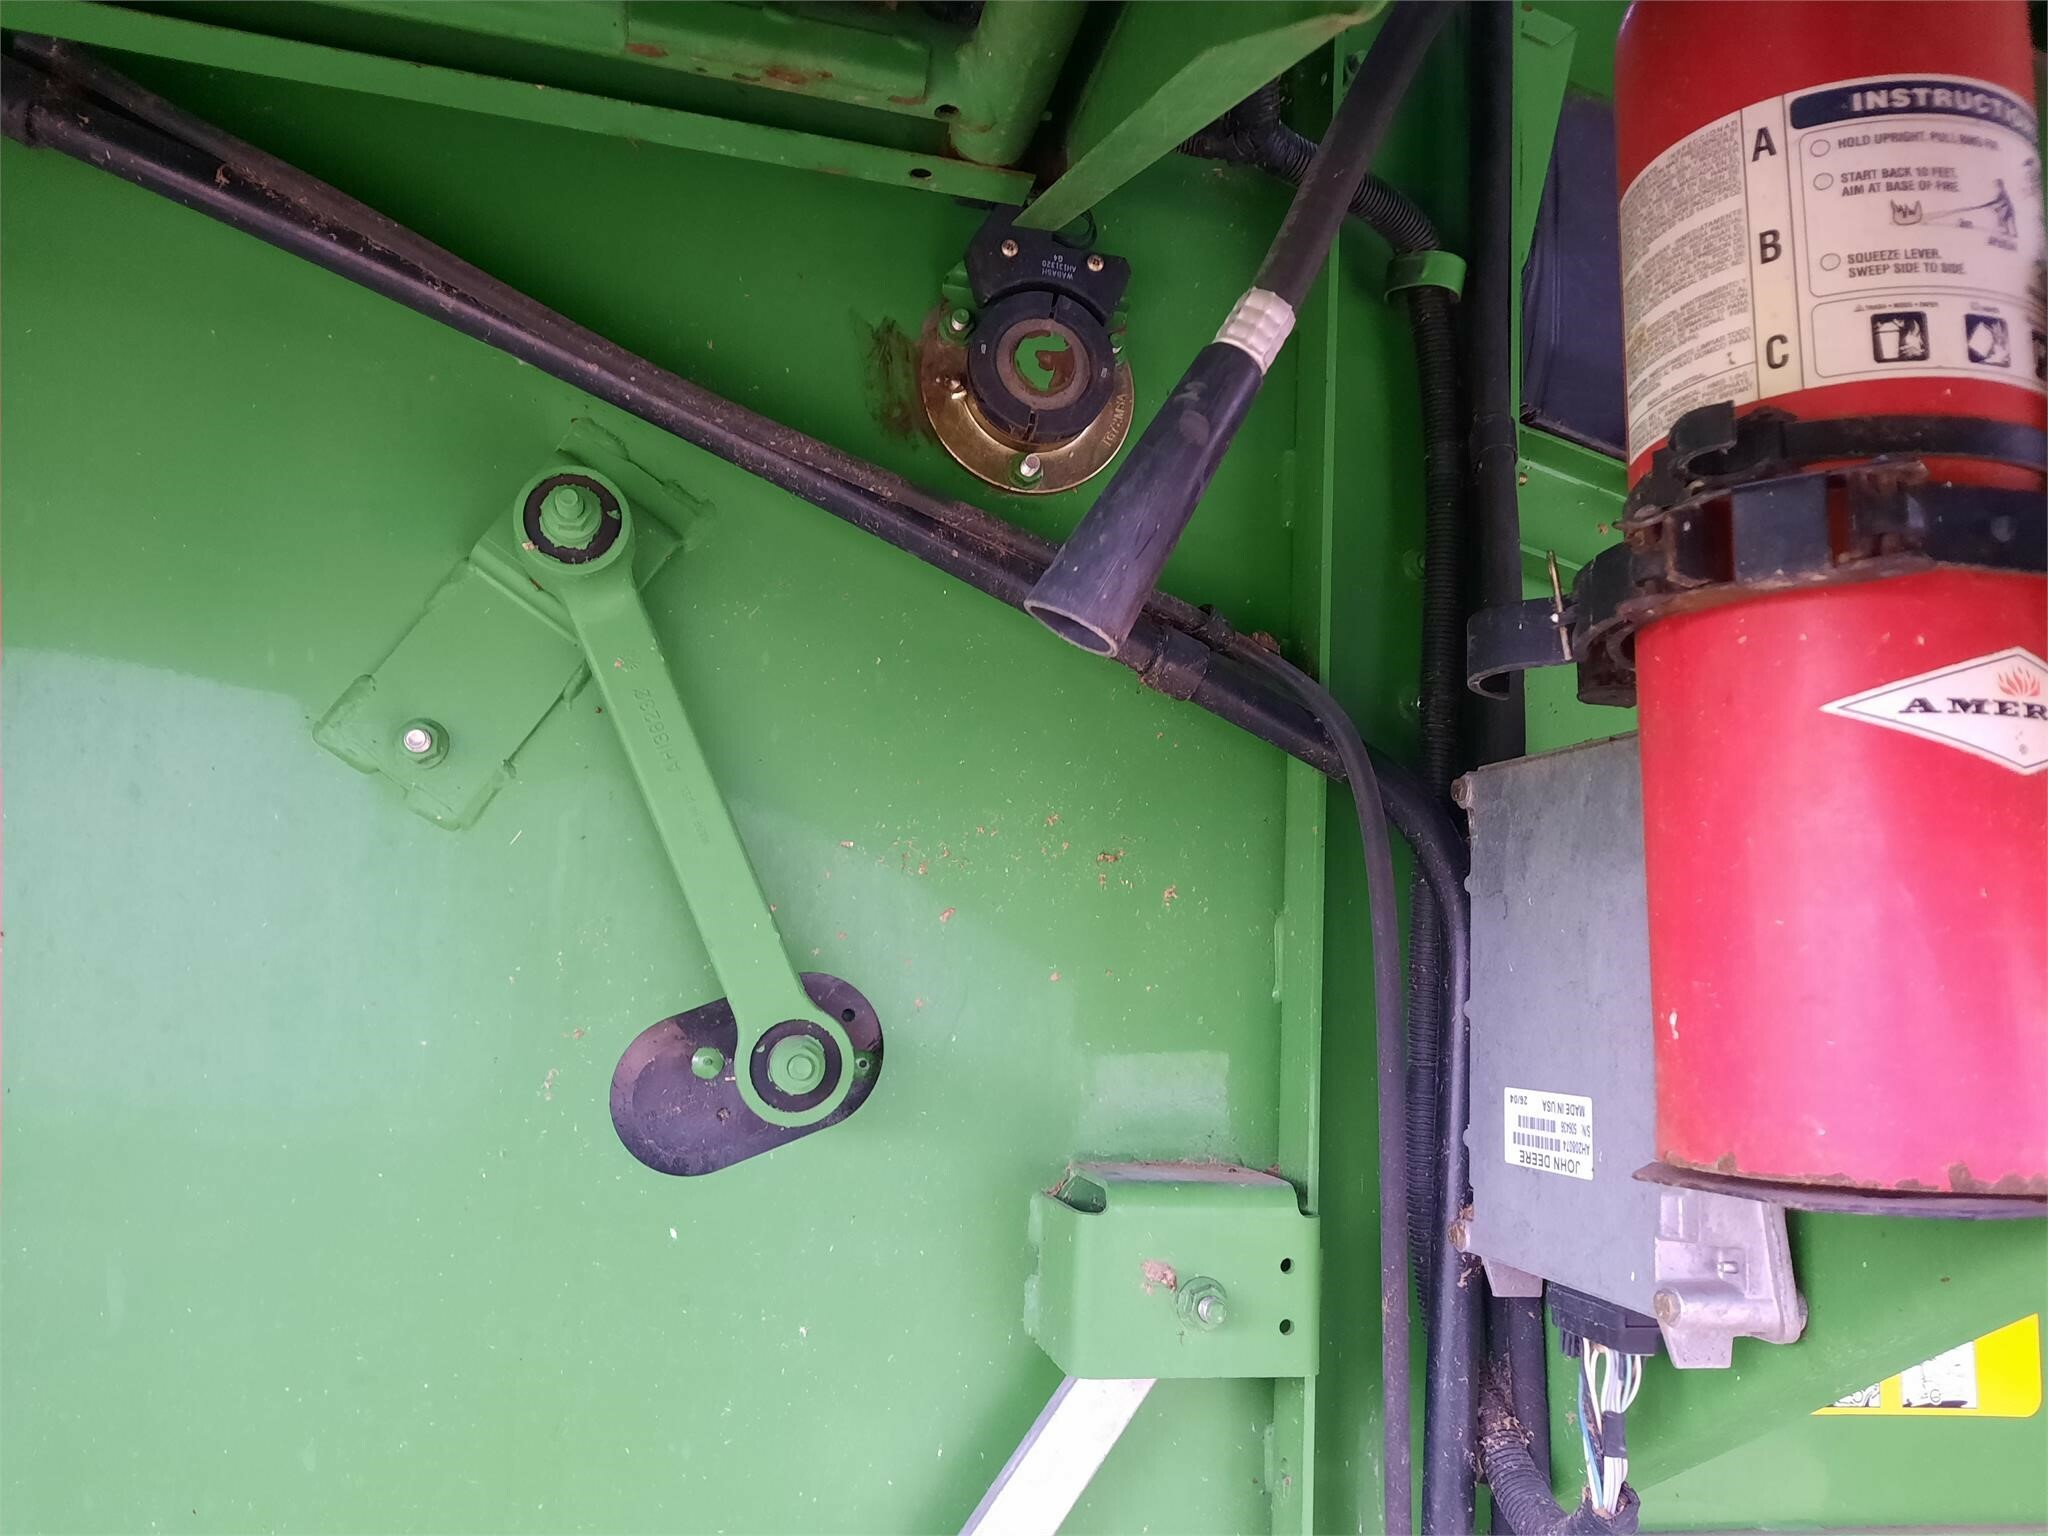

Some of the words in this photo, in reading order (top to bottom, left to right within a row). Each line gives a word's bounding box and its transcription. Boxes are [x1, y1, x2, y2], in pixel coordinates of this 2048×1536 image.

[1752, 127, 1776, 162] A
[1837, 134, 1871, 149] HOLD
[1840, 169, 1878, 184] START
[1881, 167, 1912, 180] BACK
[1916, 166, 1929, 178] 10
[1841, 183, 1865, 197] AIM
[1868, 182, 1881, 194] AT
[1886, 180, 1914, 192] BASE
[1918, 179, 1933, 191] OF
[1759, 229, 1782, 264] B
[1847, 251, 1902, 265] SQUEEZE
[1848, 265, 1891, 279] SWEEP
[1893, 263, 1920, 275] SIDE
[1923, 262, 1938, 273] TO
[1766, 334, 1790, 370] C
[1510, 1094, 1527, 1105] 26/04
[1542, 1099, 1556, 1112] USA
[1557, 1102, 1564, 1114] IN
[1566, 1103, 1585, 1118] MADE
[1519, 1150, 1551, 1168] DEERE
[1553, 1156, 1581, 1175] JOHN
